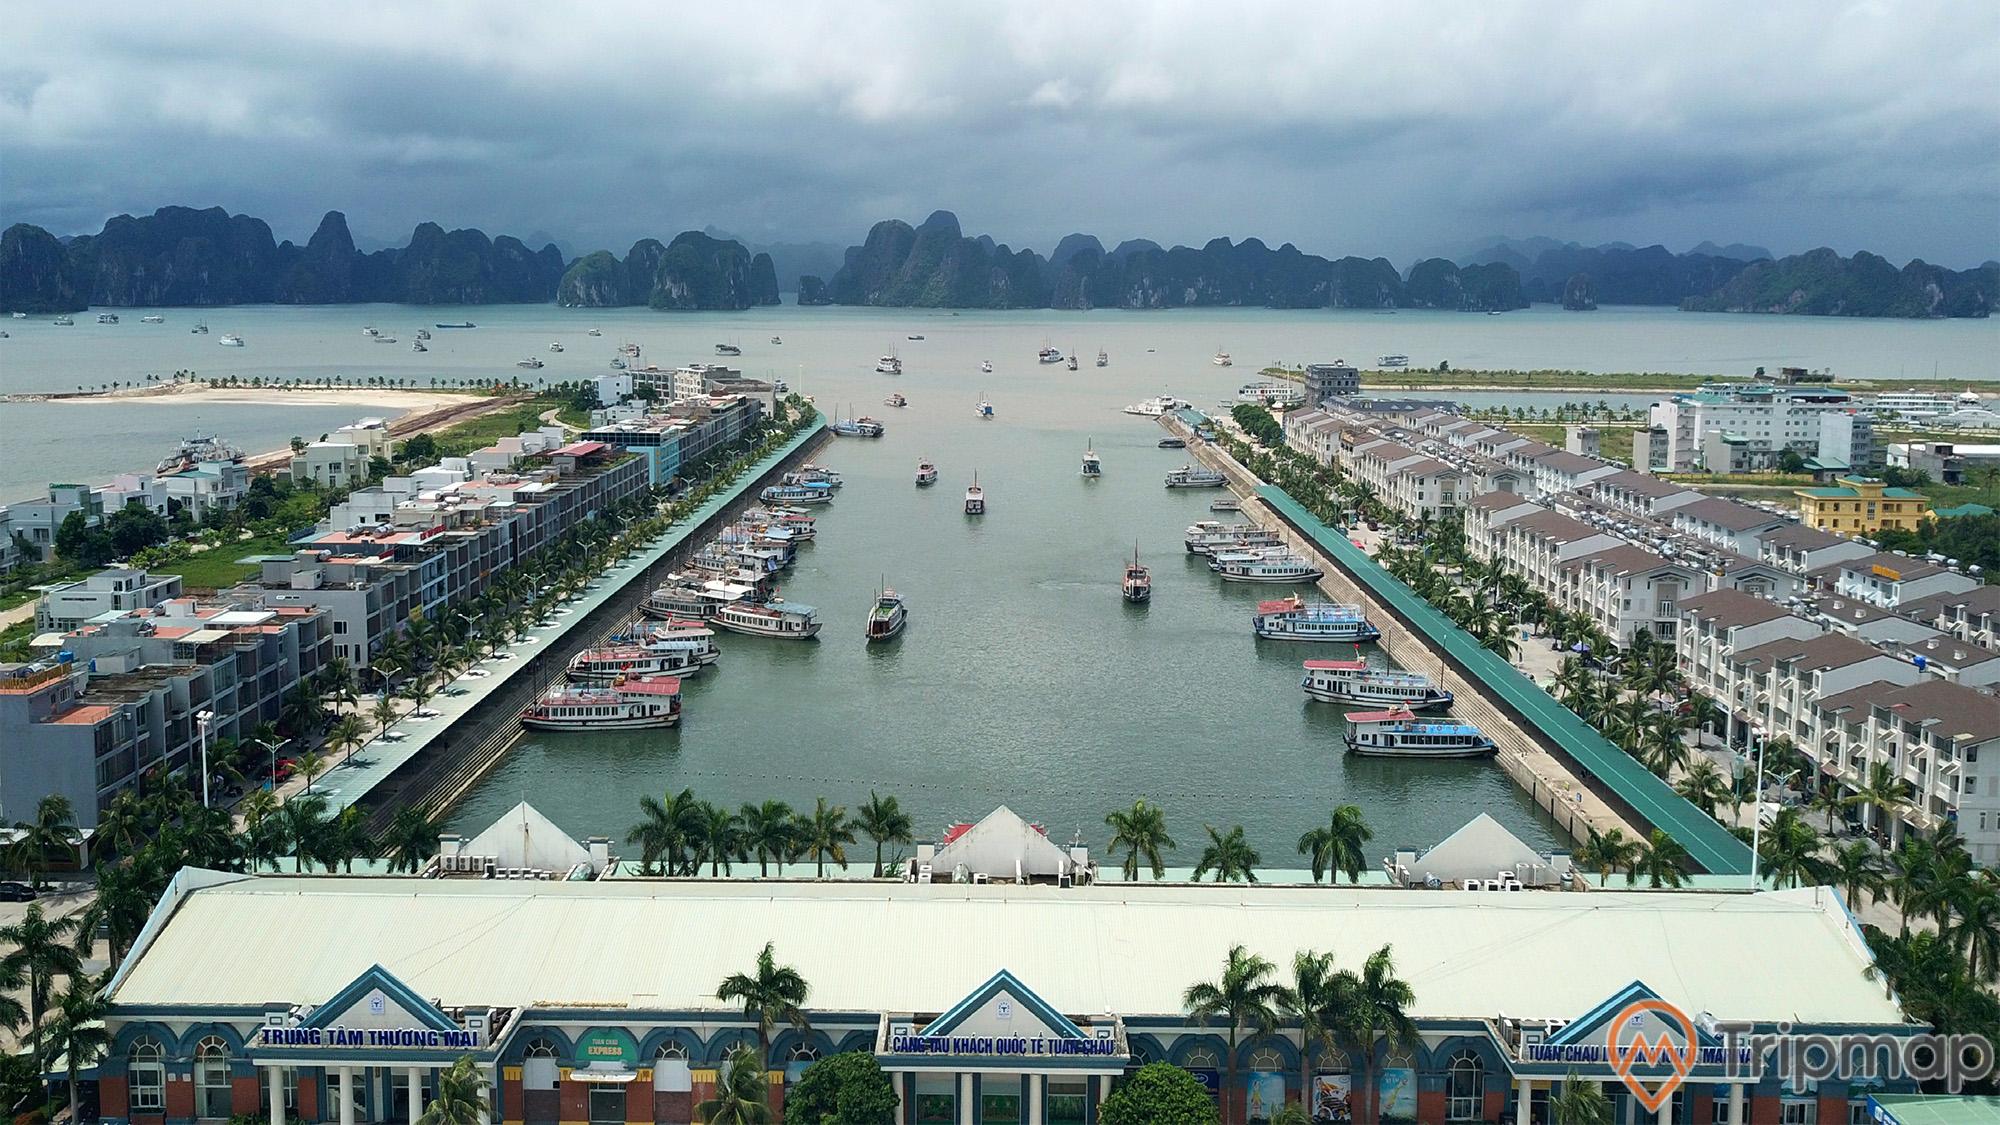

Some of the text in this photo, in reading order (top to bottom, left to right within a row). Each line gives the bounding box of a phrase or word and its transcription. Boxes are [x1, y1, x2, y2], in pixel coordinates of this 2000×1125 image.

[261, 1028, 321, 1045] TRUNG
[326, 1025, 364, 1046] TÂM
[368, 1028, 438, 1047] THƯƠNG
[952, 1032, 993, 1054] KHÁCH
[995, 1031, 1027, 1055] QUỐC
[1030, 1031, 1044, 1054] TẾ
[587, 1046, 623, 1056] EXPRESS
